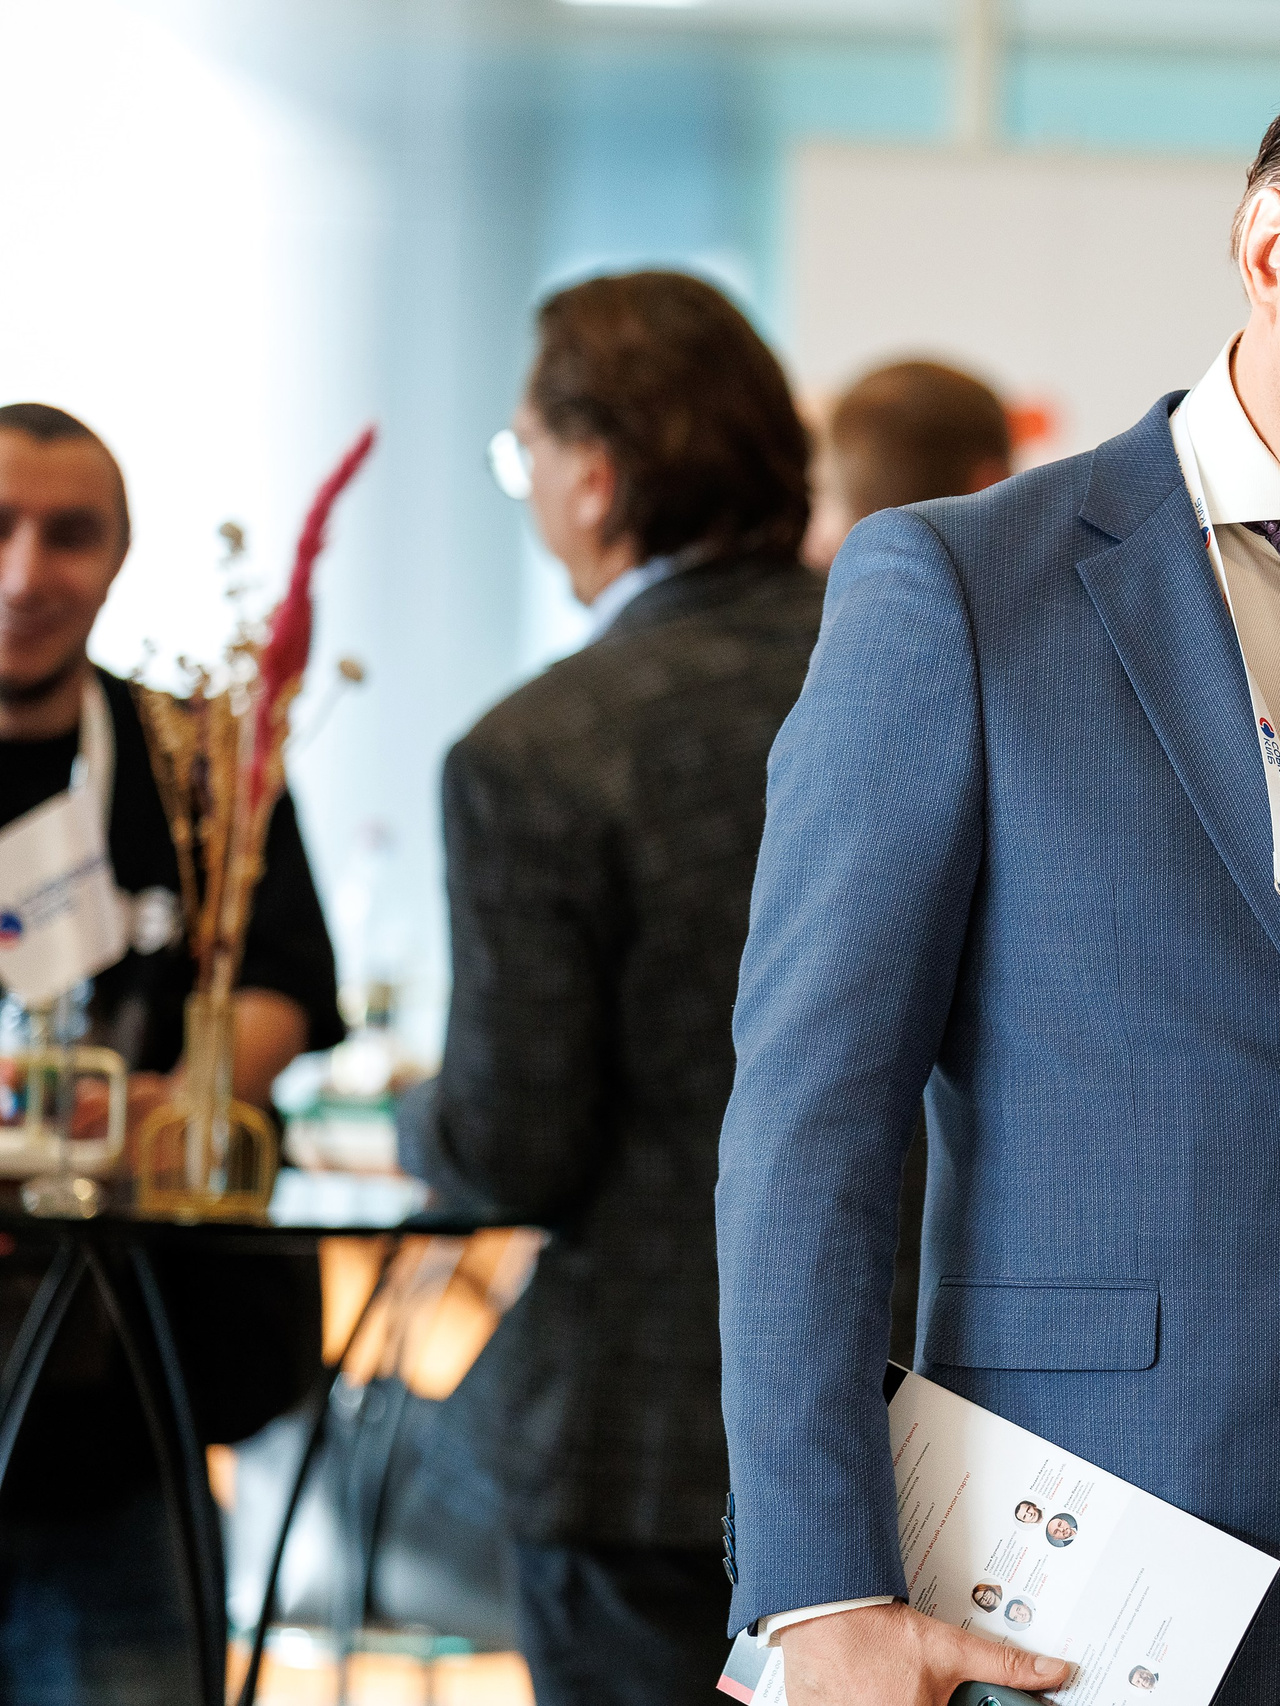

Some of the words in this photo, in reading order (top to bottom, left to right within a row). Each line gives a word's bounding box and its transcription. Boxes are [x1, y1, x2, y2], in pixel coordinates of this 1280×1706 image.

[1263, 737, 1276, 765] КИБ
[892, 1442, 908, 1466] дового
[906, 1570, 921, 1593] дущее
